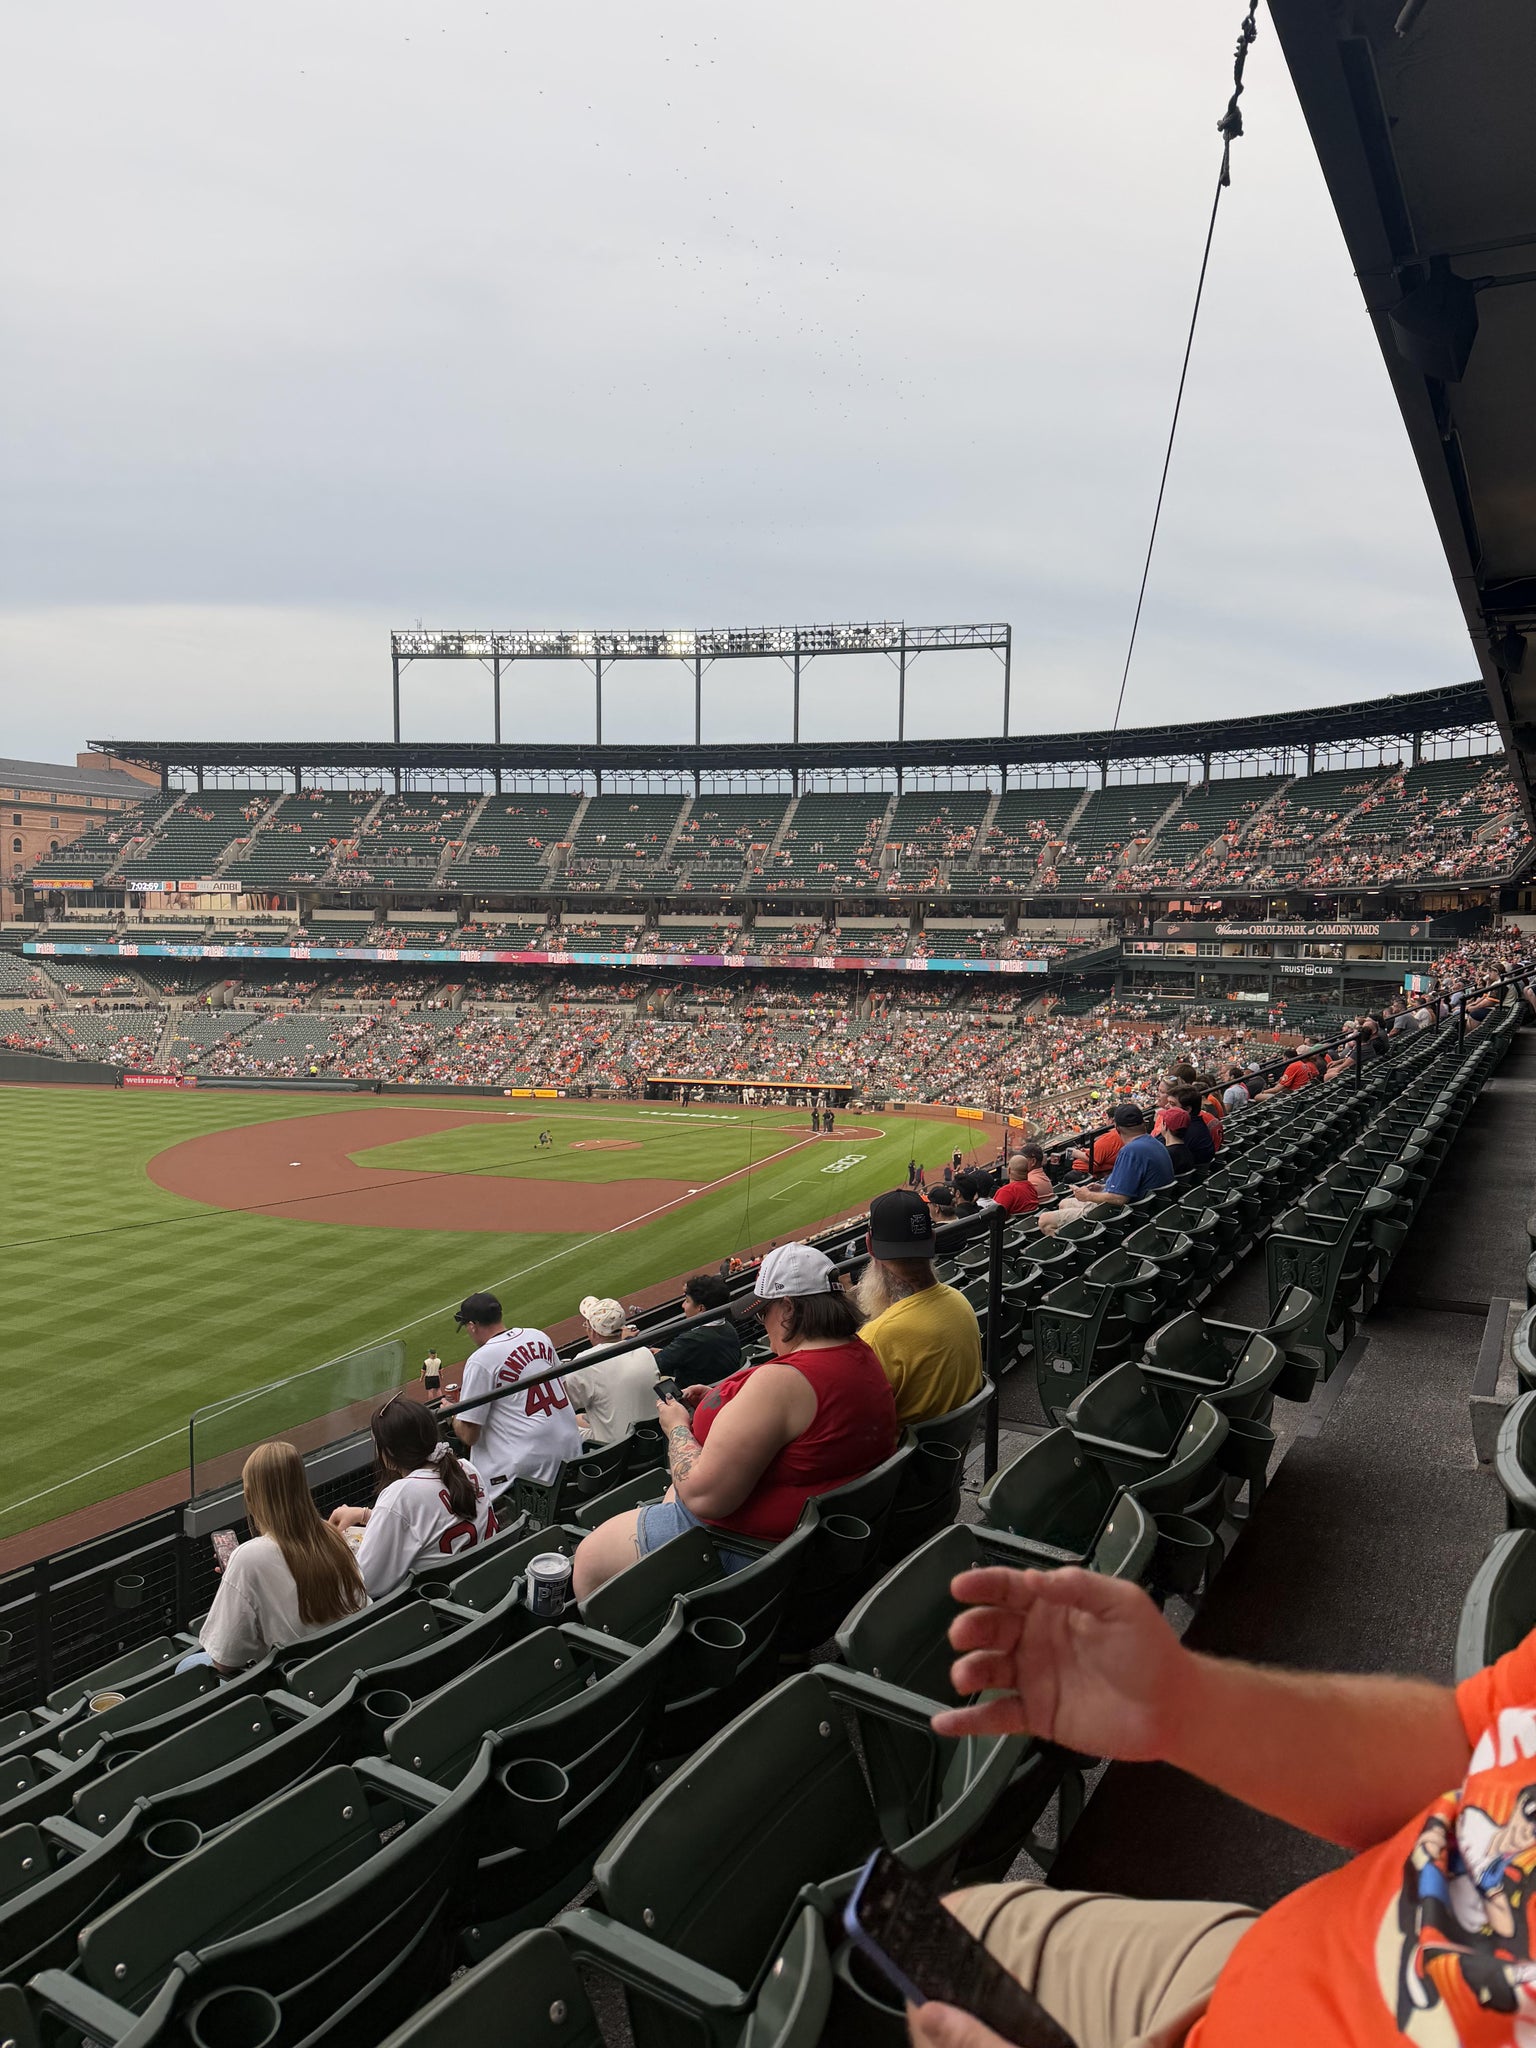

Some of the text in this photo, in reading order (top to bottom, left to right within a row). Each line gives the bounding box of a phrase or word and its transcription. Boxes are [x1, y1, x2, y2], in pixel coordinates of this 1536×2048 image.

[1215, 924, 1242, 935] Welcome
[1248, 925, 1283, 935] ORIOLE
[1284, 925, 1306, 935] PARK
[1316, 925, 1353, 935] CAMDEN
[1353, 925, 1380, 935] YARDS
[1280, 965, 1333, 974] TRUIST CLUB
[1059, 1361, 1065, 1371] 4
